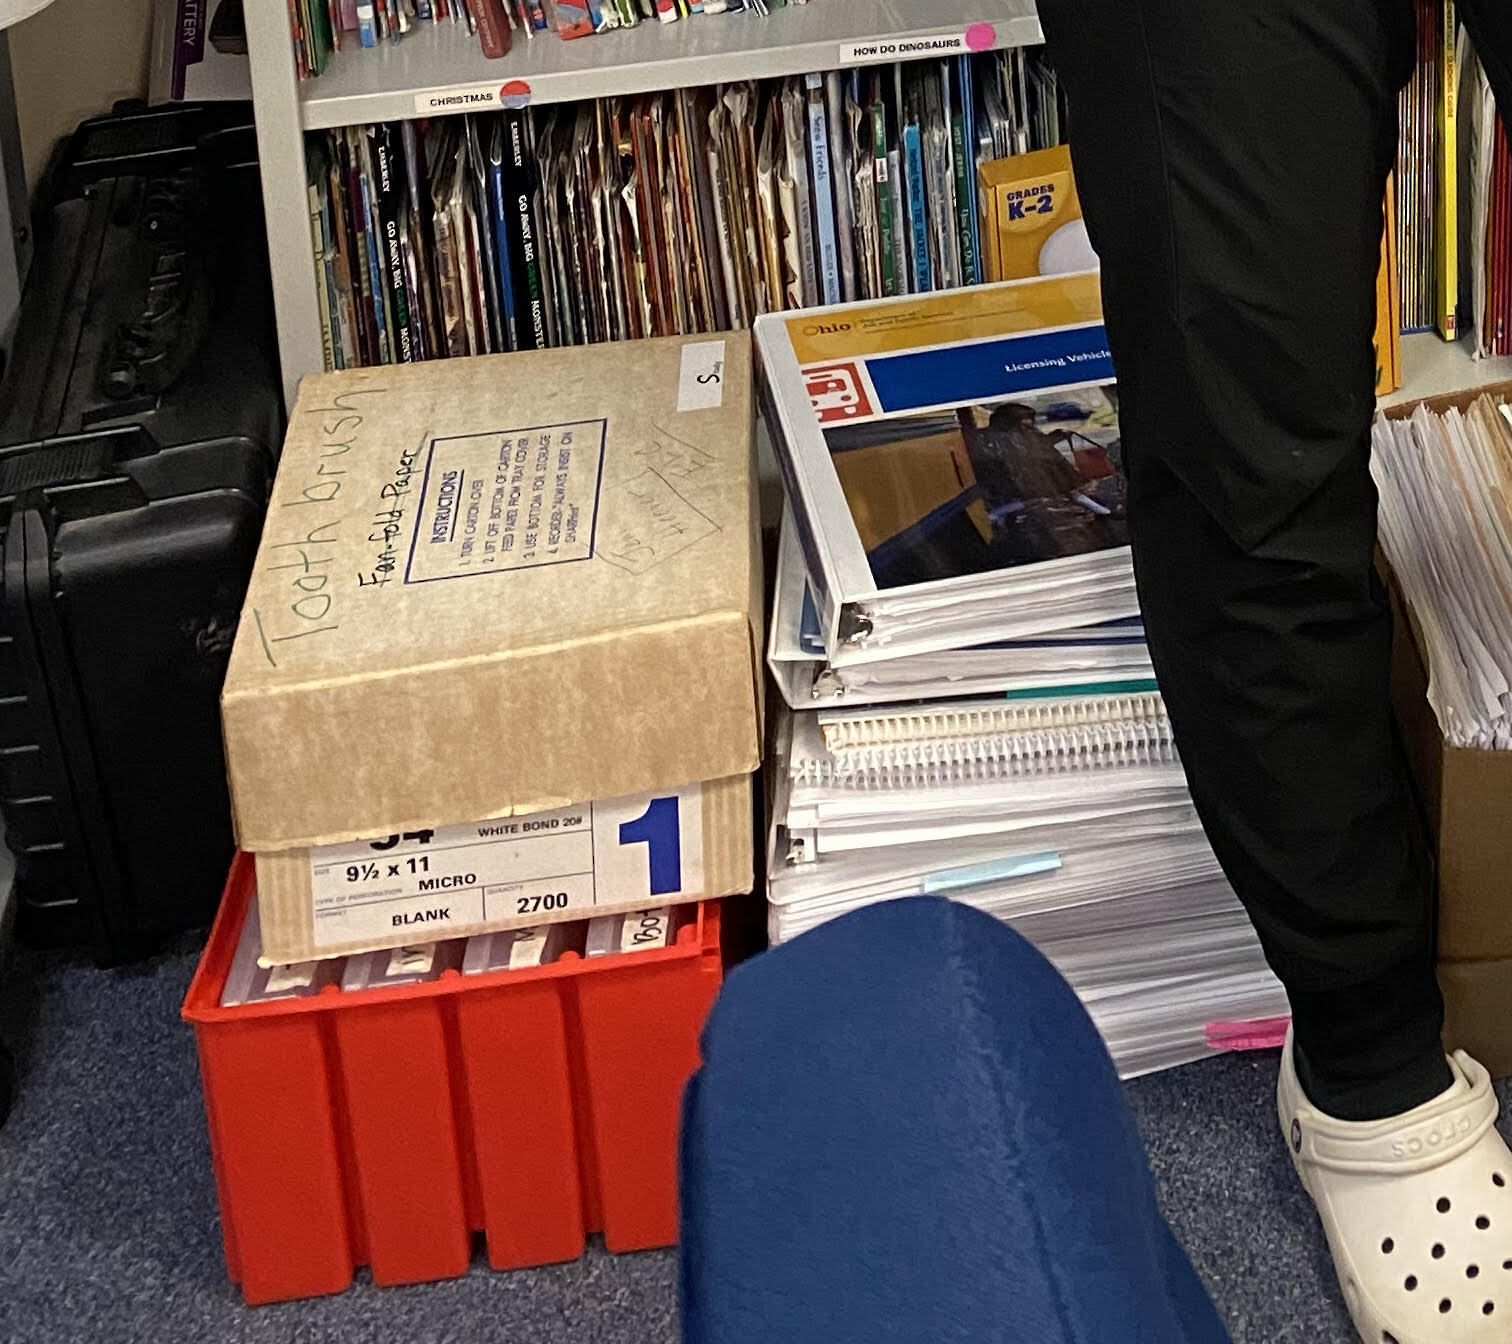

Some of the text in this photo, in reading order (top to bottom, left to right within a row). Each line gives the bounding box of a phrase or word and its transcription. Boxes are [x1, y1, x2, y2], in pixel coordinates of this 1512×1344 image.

[854, 39, 961, 56] HOW DO DINOSAURS
[430, 92, 493, 107] CHRISTMAS
[1007, 183, 1055, 202] GRADES
[1008, 196, 1054, 219] K-2
[802, 322, 850, 336] Ohio
[1005, 357, 1065, 372] Licensing
[381, 449, 423, 500] Paper
[431, 470, 458, 543] INSTRUCTIONS
[254, 387, 387, 667] Tooth brush
[478, 820, 559, 838] WHITE BOND
[618, 795, 682, 896] 1
[388, 864, 400, 876] x
[406, 856, 430, 874] 11
[418, 874, 477, 891] MICRO
[517, 892, 569, 914] 2700
[391, 908, 450, 927] BLANK
[1391, 1118, 1472, 1159] crocs
